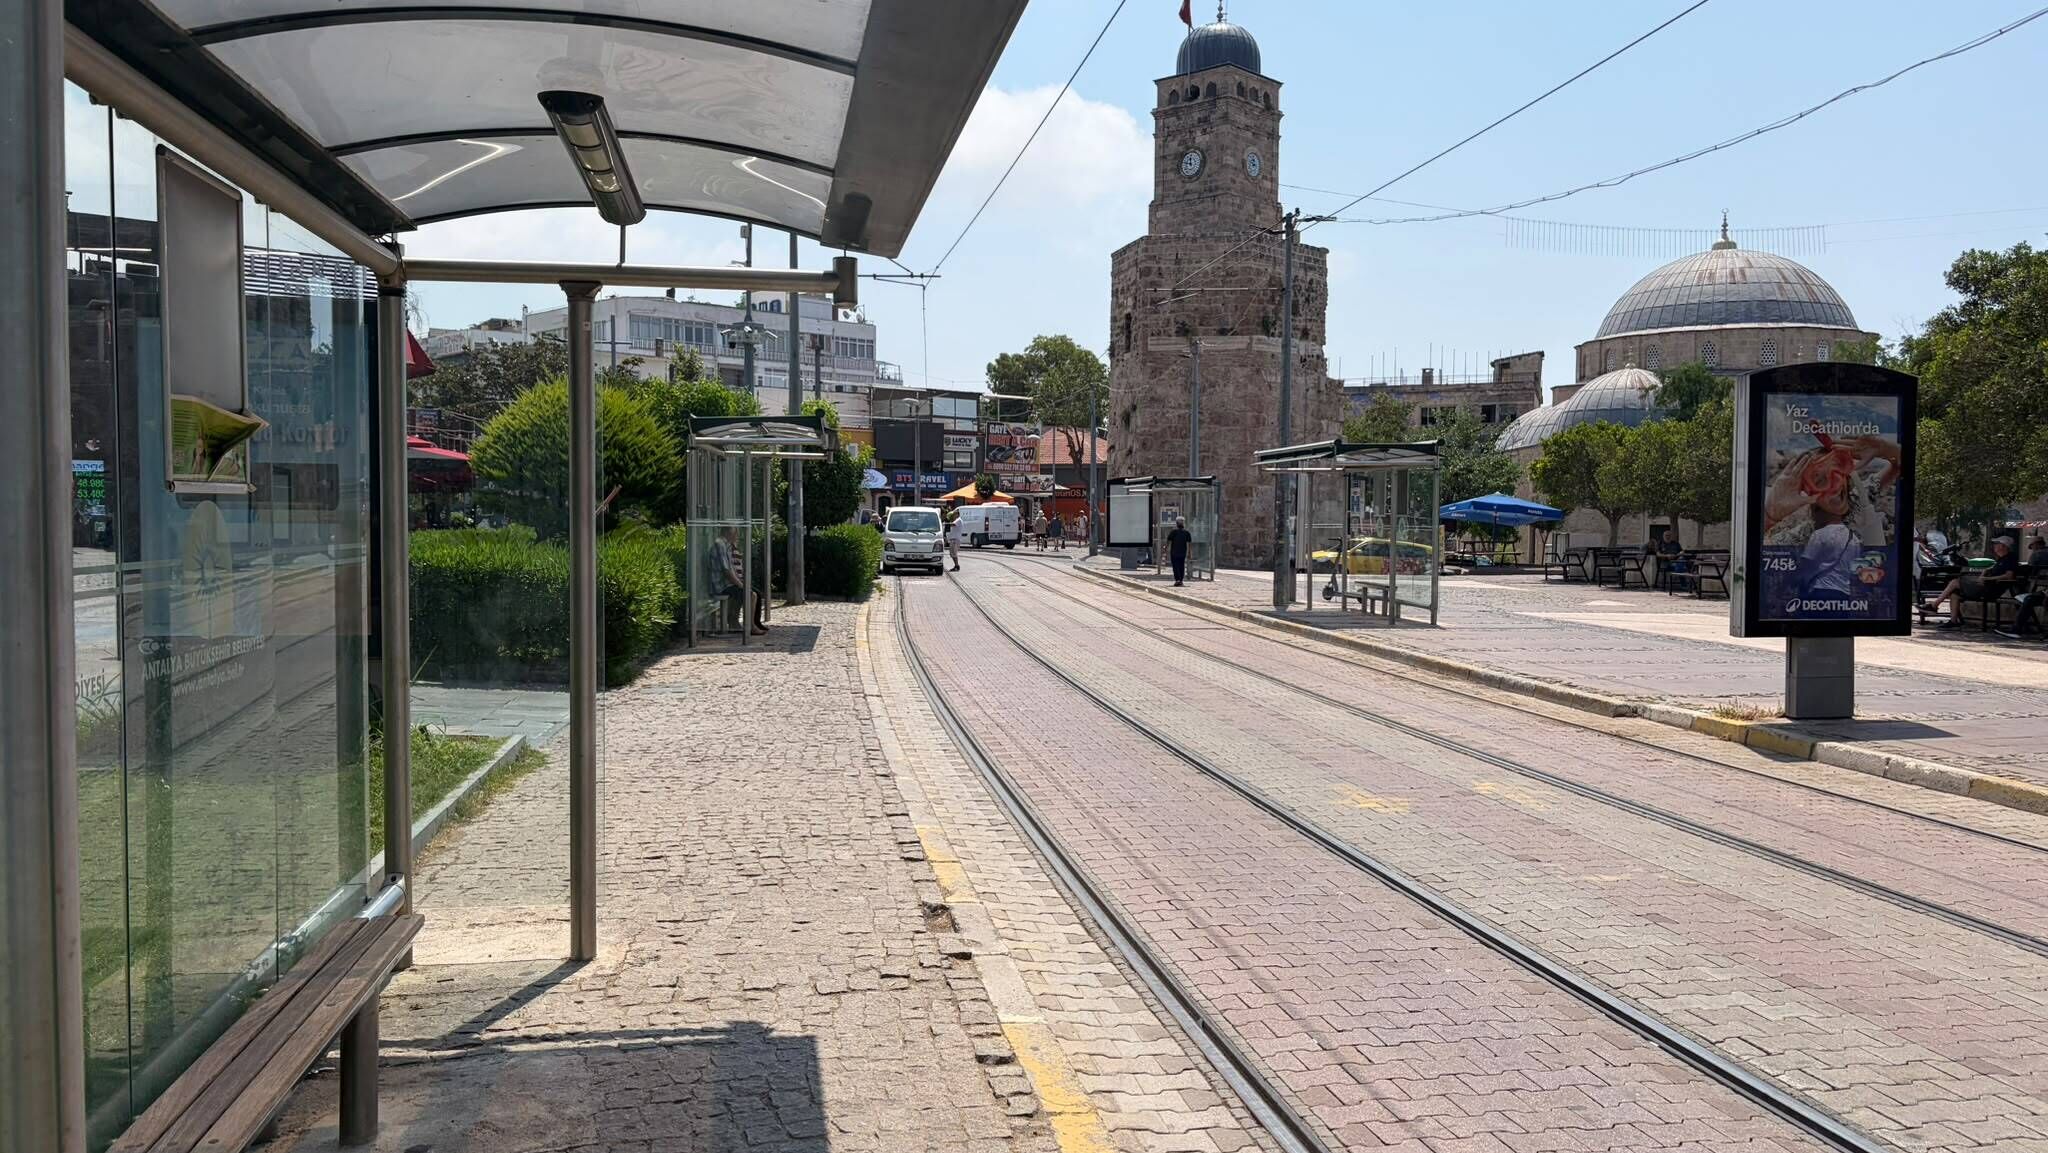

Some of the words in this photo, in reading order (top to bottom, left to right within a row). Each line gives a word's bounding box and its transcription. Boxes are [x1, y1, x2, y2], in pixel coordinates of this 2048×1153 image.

[1785, 403, 1809, 417] Yaz
[1792, 420, 1880, 435] Decathlon'da
[896, 474, 913, 482] BTS
[919, 474, 947, 483] RAVEL
[1802, 600, 1868, 611] DECATHLON
[141, 654, 183, 681] ANTALYA
[183, 642, 231, 673] BÜYÜKŞEHİR
[74, 667, 105, 700] DİYESİ
